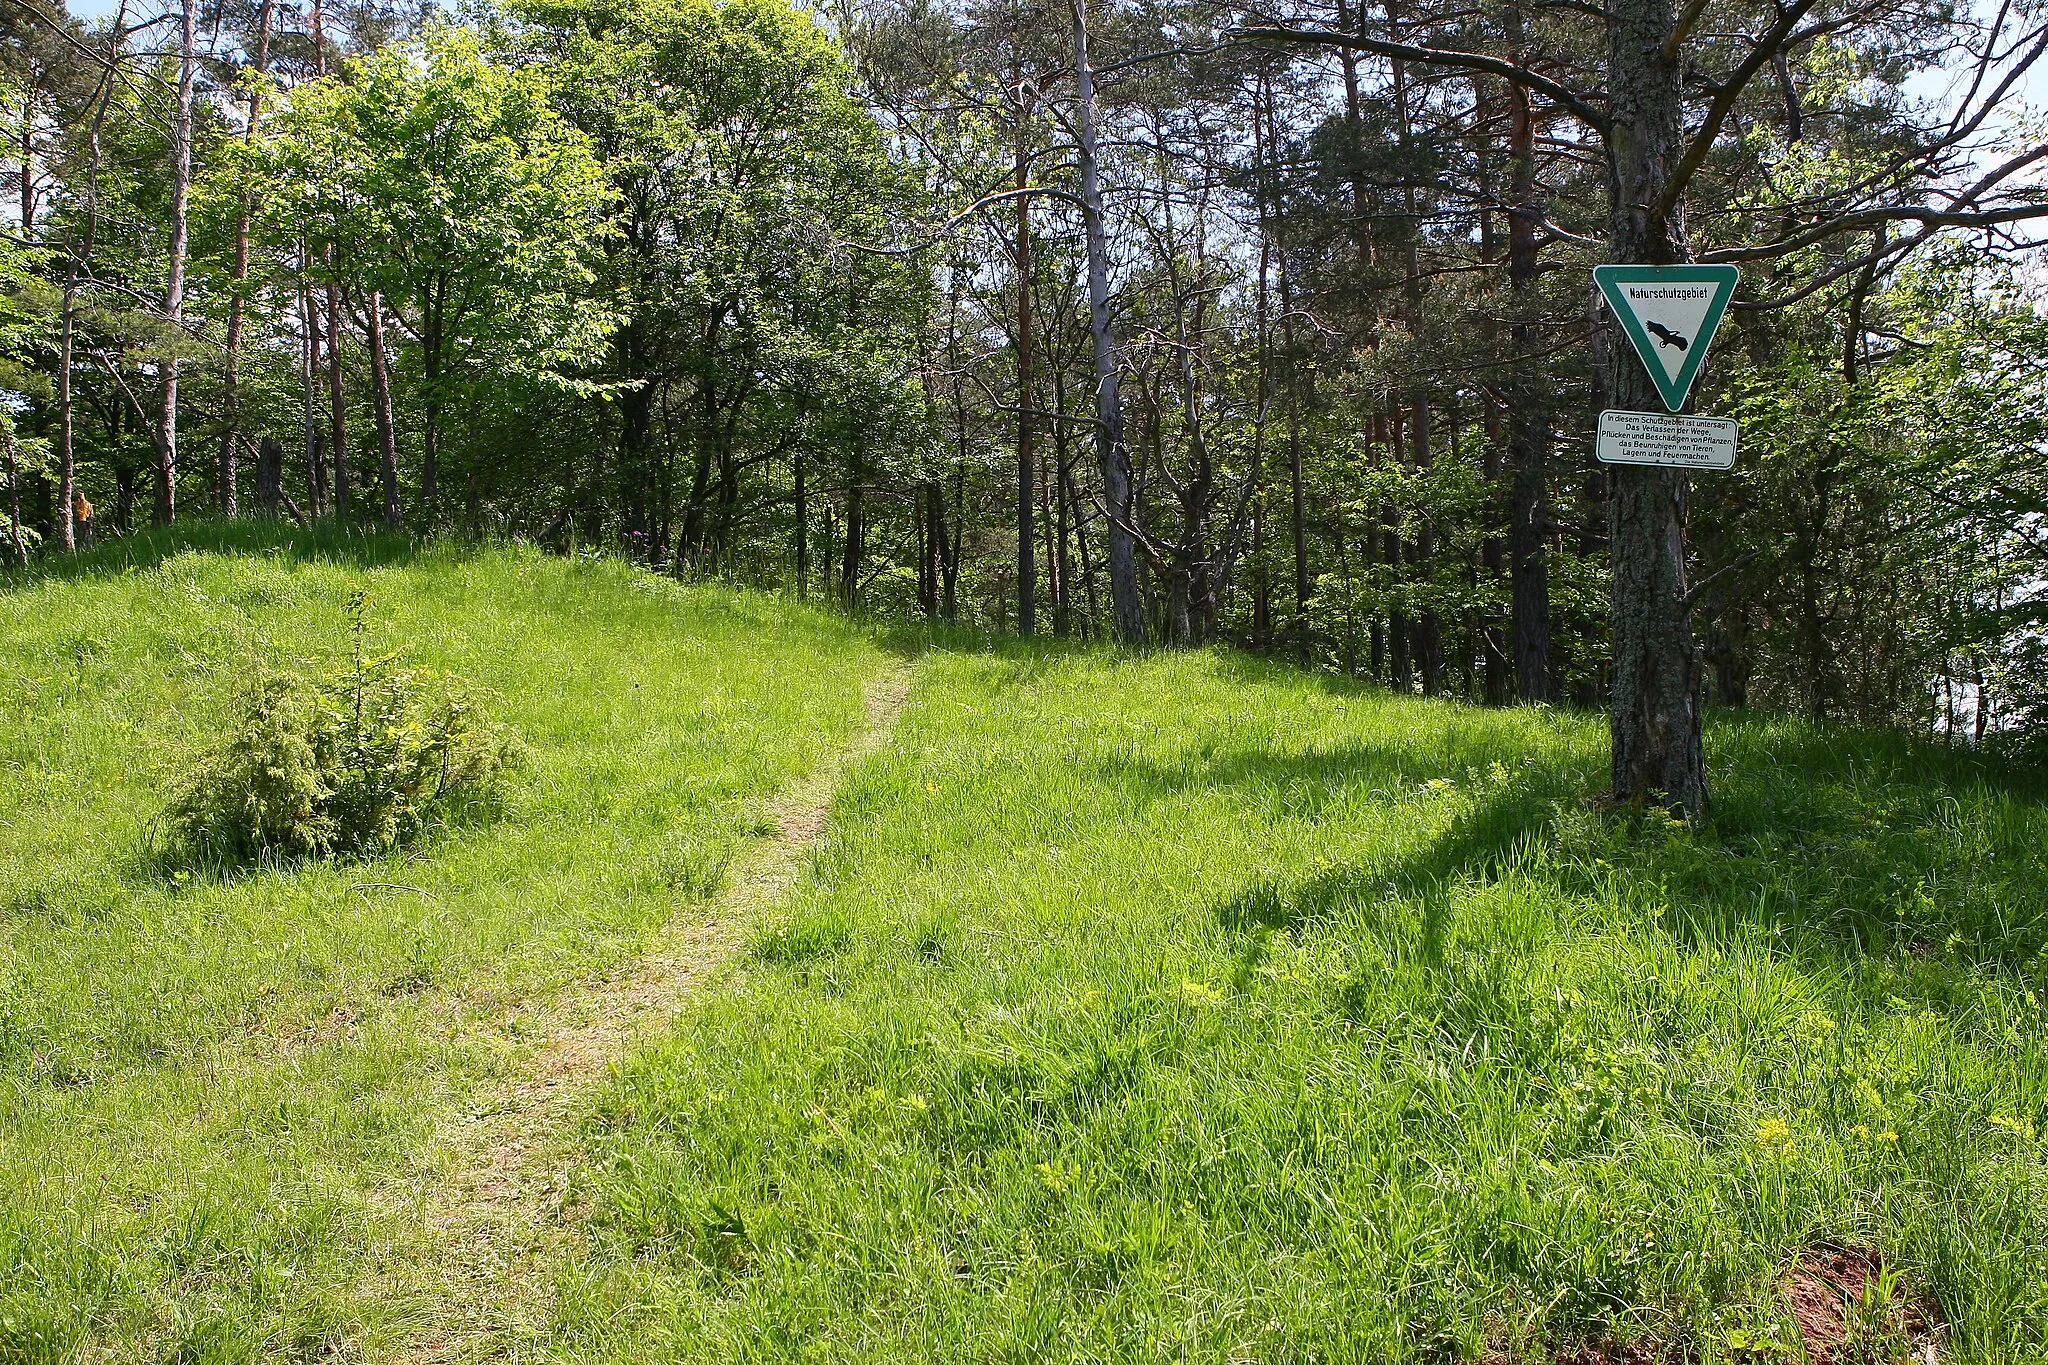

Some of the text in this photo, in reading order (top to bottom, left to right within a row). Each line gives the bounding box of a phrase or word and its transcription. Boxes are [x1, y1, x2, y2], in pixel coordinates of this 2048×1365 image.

[1630, 287, 1708, 300] Naturschutzgebiet
[1641, 416, 1684, 426] Schutzgebiet
[1690, 428, 1711, 436] Wege,
[1703, 436, 1733, 446] Pflanzen,
[1634, 441, 1676, 450] Beunruhigen
[1692, 444, 1714, 453] Tieren,
[1622, 449, 1646, 457] Lagern
